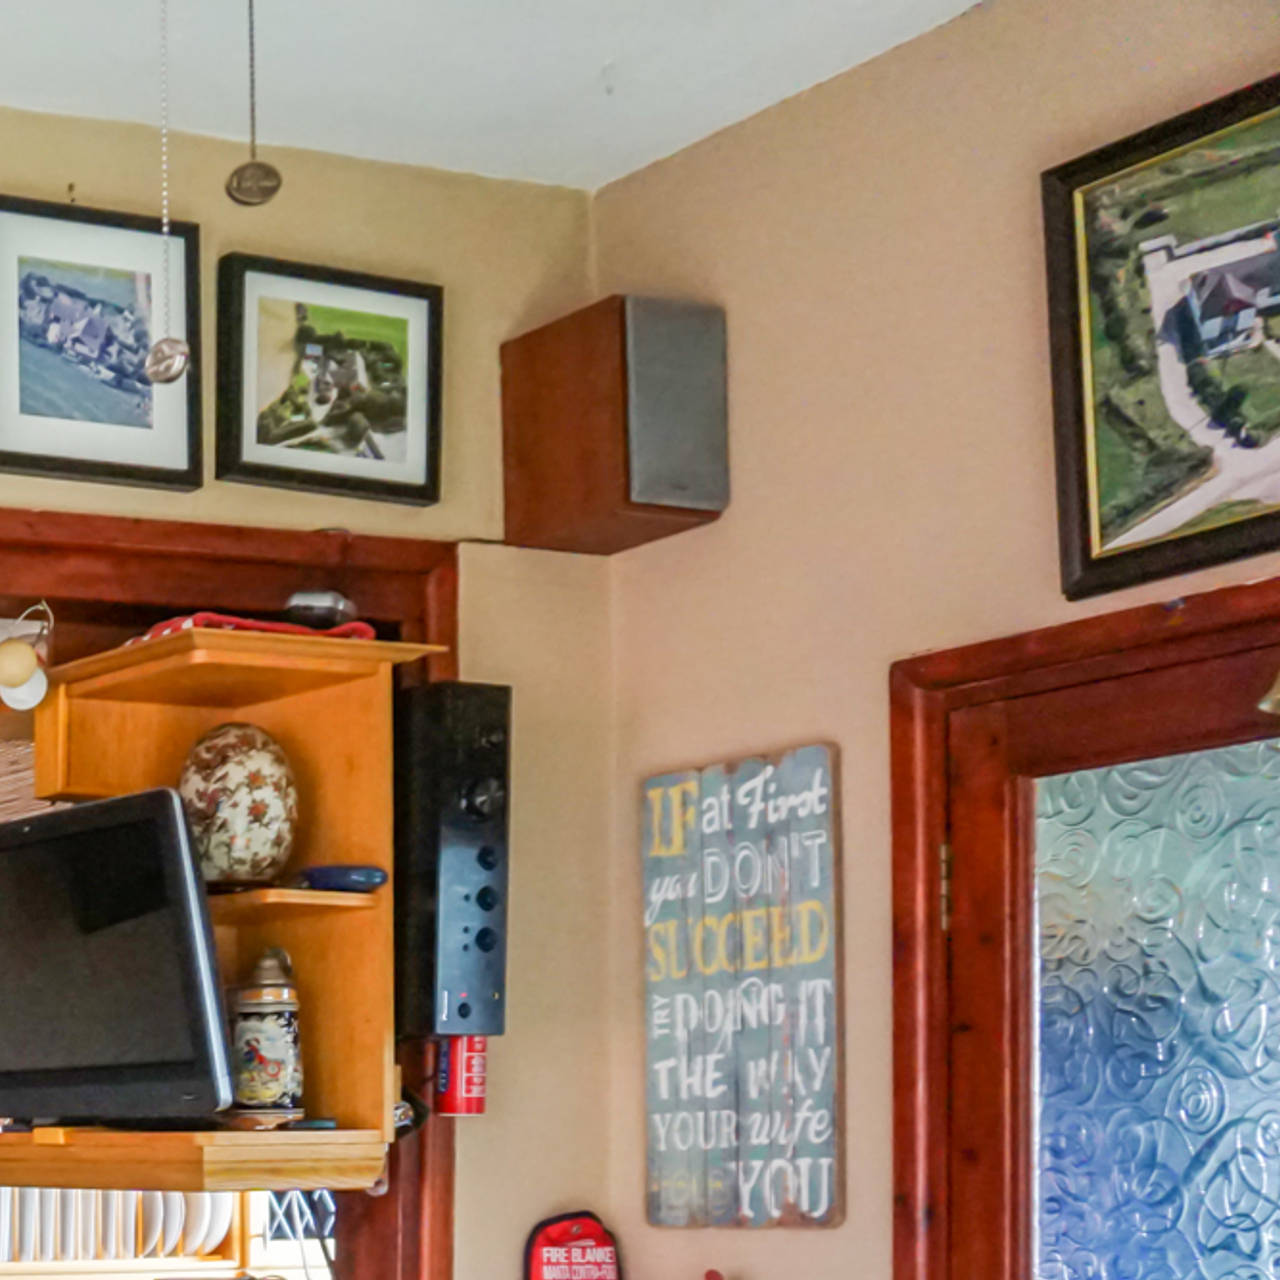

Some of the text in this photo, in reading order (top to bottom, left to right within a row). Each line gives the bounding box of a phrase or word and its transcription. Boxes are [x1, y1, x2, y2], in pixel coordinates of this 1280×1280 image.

[647, 765, 828, 857] IF at First
[703, 829, 828, 904] DON'T
[648, 899, 831, 983] SUCCEED
[652, 976, 833, 1054] TRY DOING IT
[653, 1053, 728, 1101] THE
[652, 1108, 738, 1152] YOUR
[730, 1156, 834, 1220] YOU
[542, 1246, 616, 1263] FIRE BLANKE
